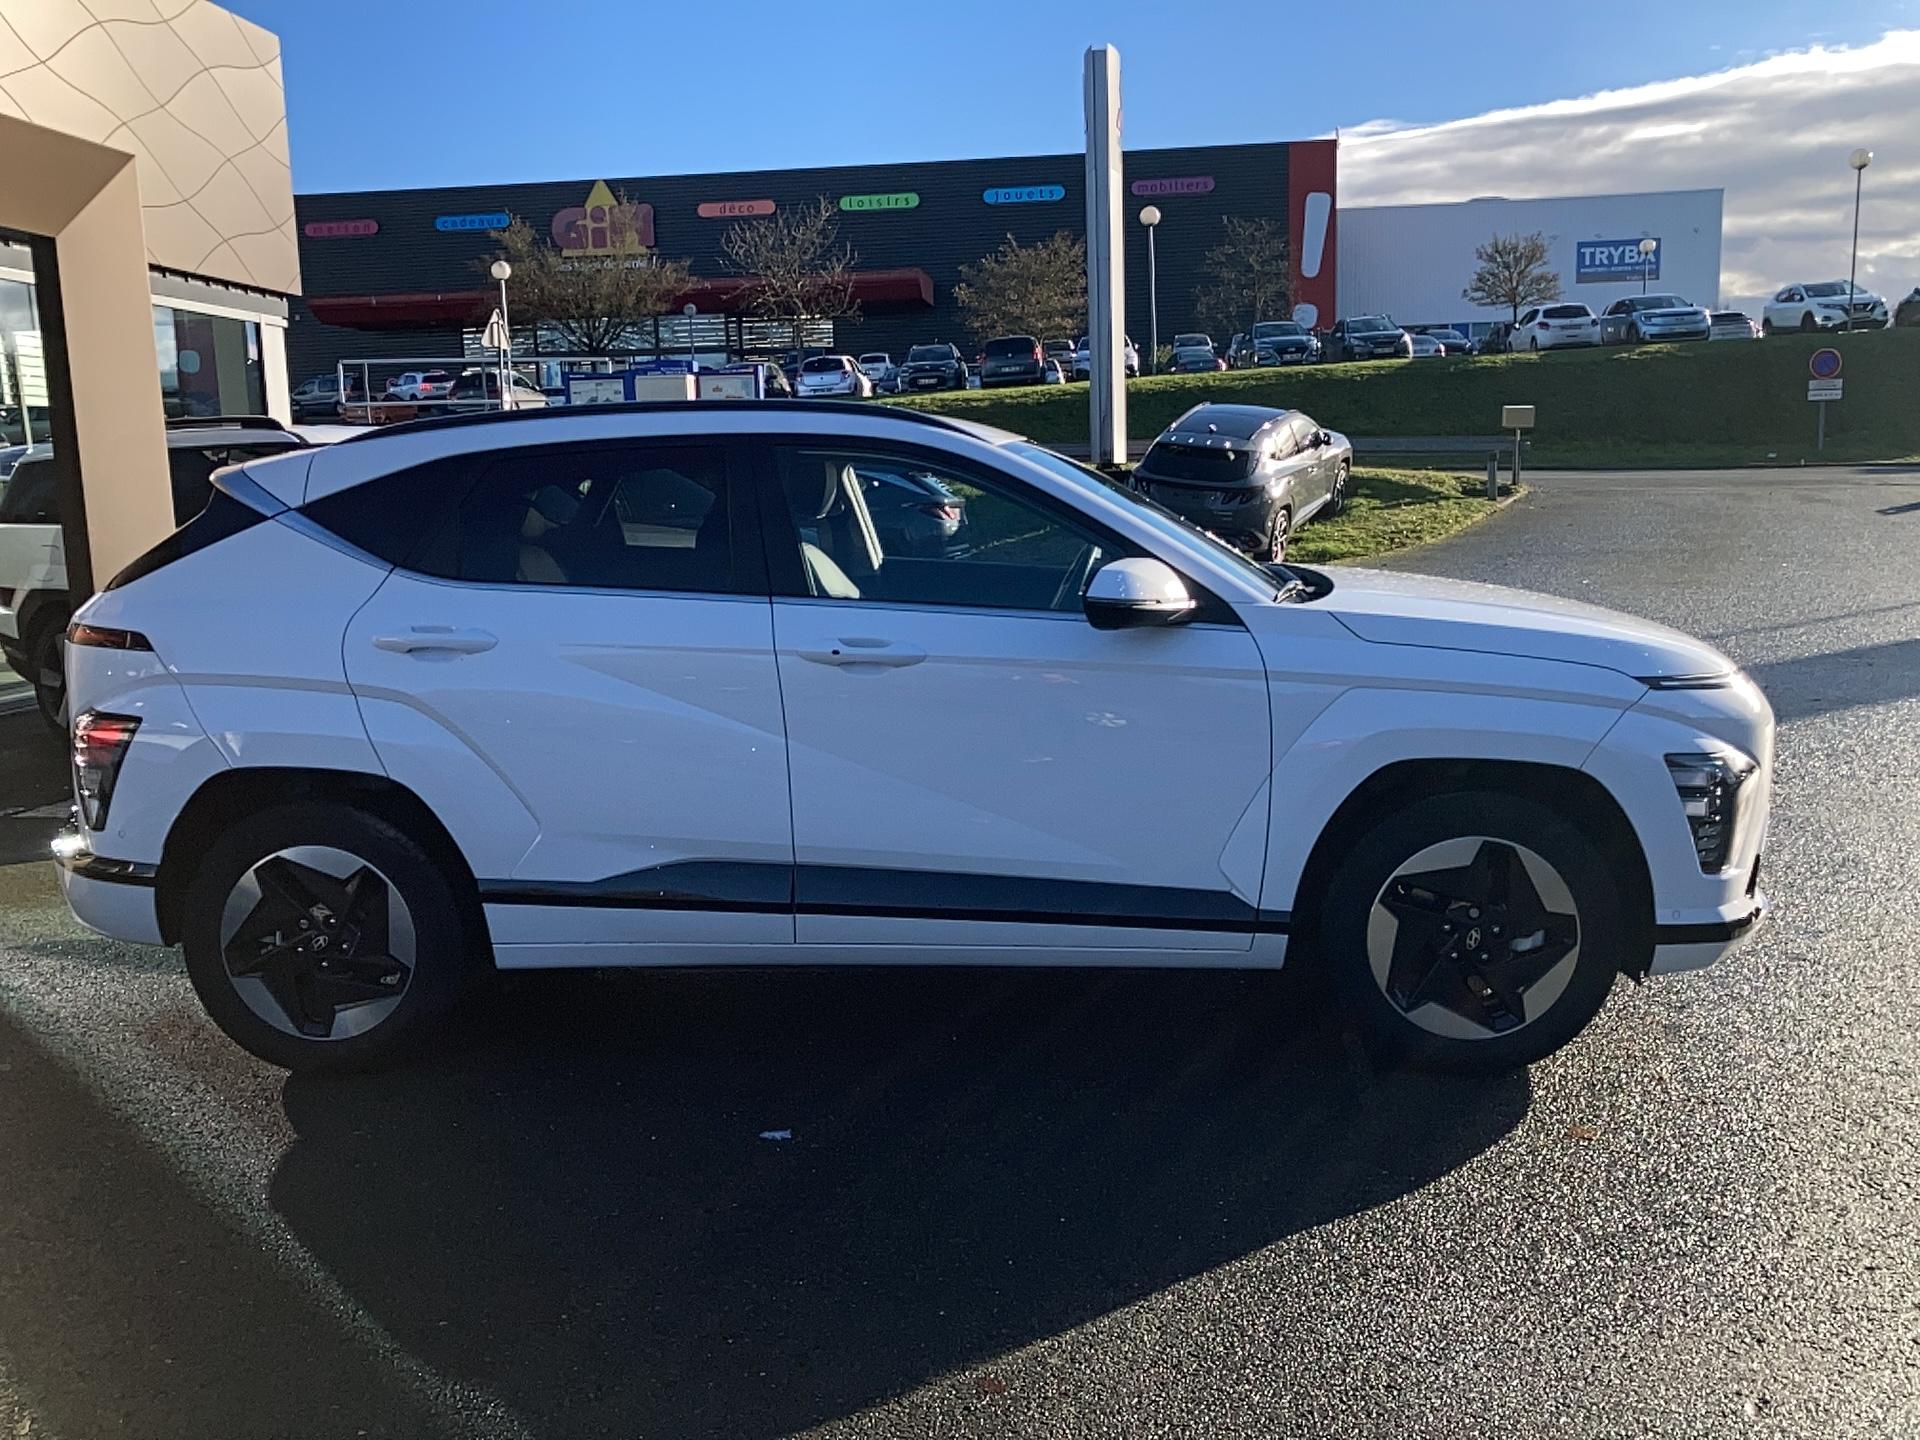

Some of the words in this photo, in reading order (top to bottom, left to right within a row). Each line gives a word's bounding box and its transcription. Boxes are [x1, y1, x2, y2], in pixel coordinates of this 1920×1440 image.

[1136, 180, 1211, 194] mobiliers
[848, 195, 910, 209] loisirs
[994, 187, 1055, 204] jouets
